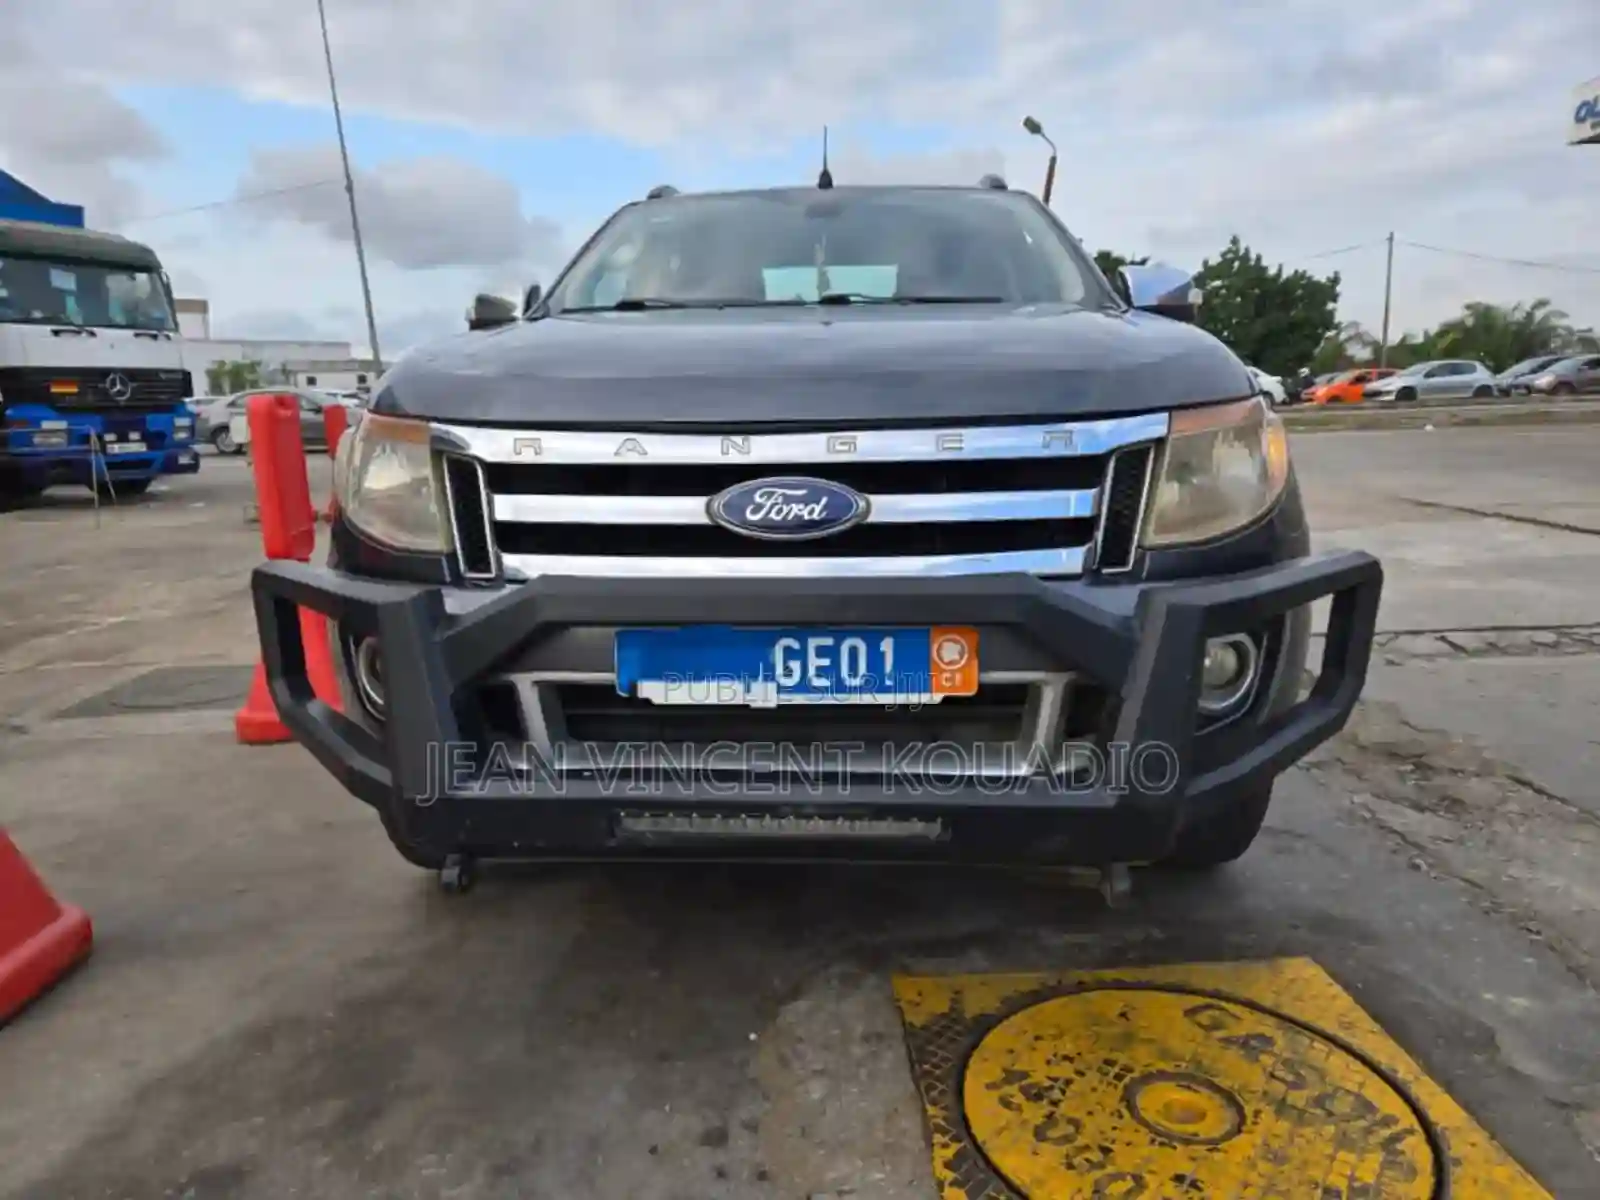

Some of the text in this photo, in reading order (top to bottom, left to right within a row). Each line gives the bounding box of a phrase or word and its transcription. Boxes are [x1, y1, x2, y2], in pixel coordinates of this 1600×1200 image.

[513, 430, 1074, 456] RANGER
[745, 488, 828, 522] Ford
[942, 672, 963, 688] CI
